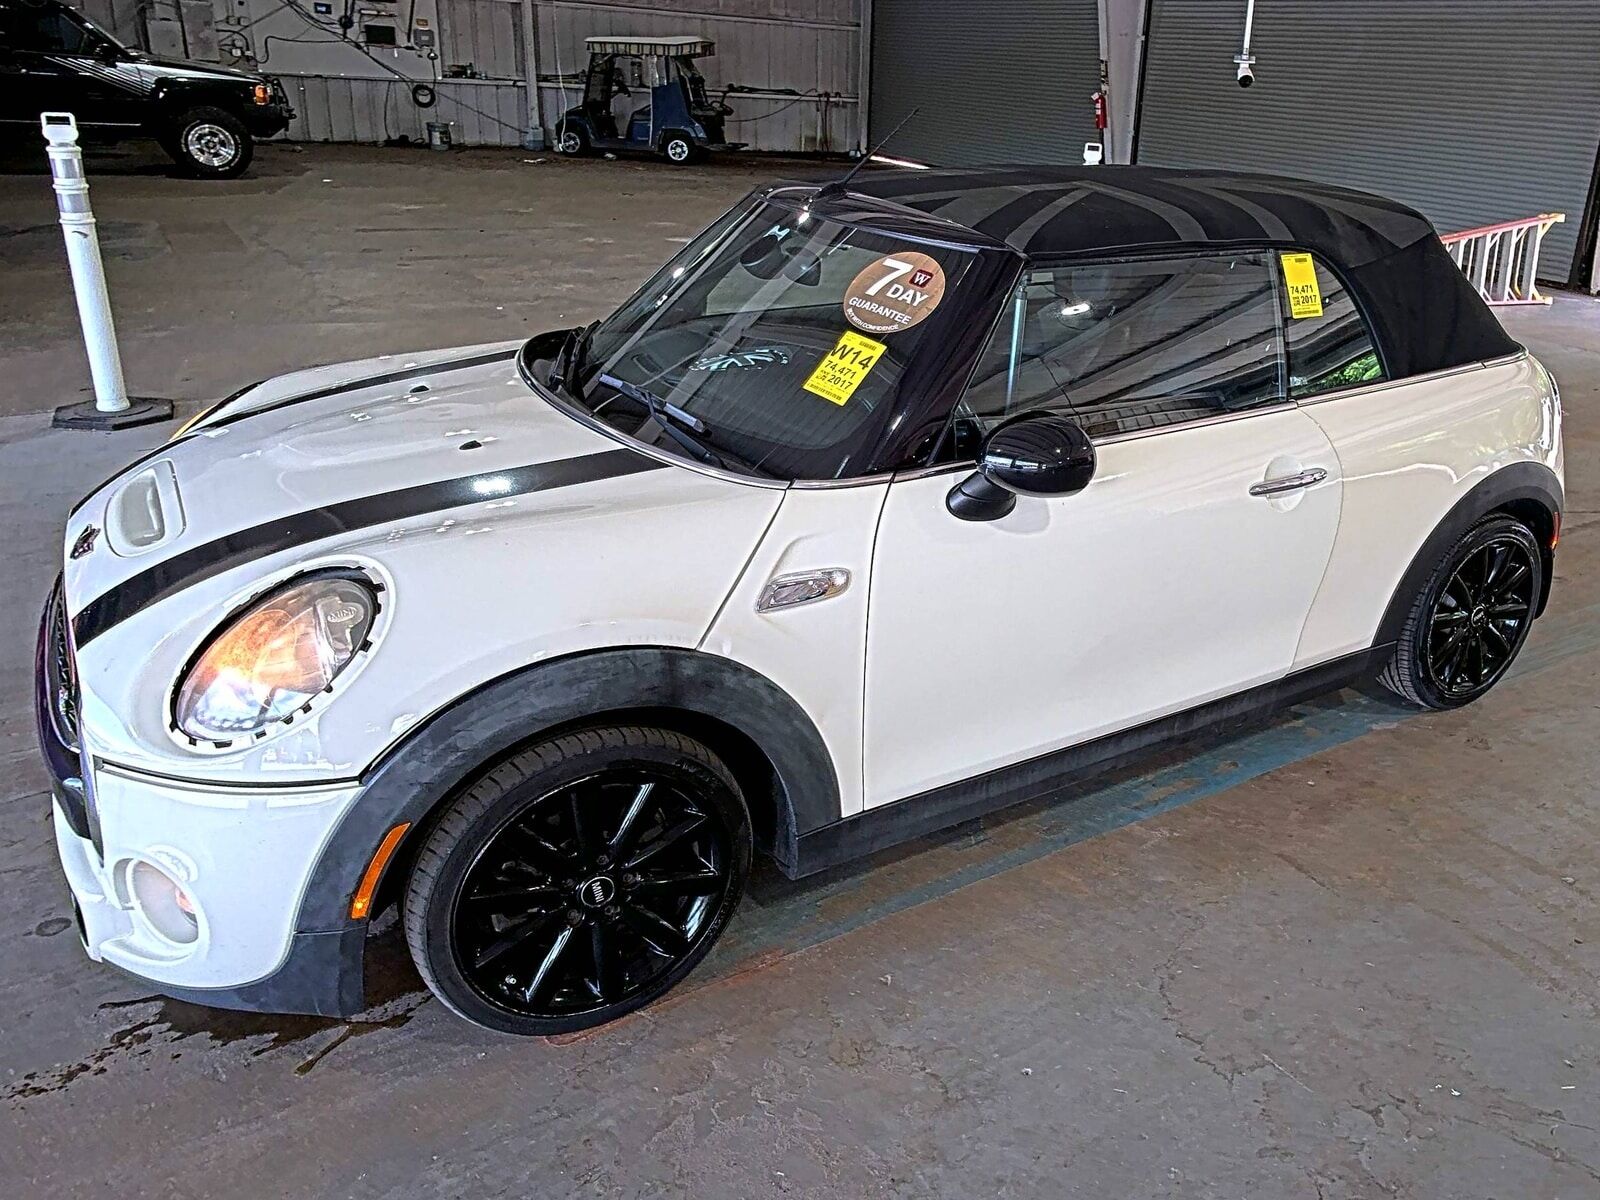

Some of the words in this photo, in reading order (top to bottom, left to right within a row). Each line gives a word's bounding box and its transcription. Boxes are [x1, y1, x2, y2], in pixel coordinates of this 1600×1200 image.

[865, 258, 914, 297] 7
[914, 271, 932, 285] W
[886, 284, 929, 307] DAY
[1290, 285, 1314, 295] 74,471
[1301, 295, 1317, 304] 2017
[849, 297, 912, 325] GUARANTEE
[830, 344, 874, 370] W14
[825, 360, 857, 379] 74,471
[827, 374, 853, 390] 2017
[591, 881, 605, 903] MINI
